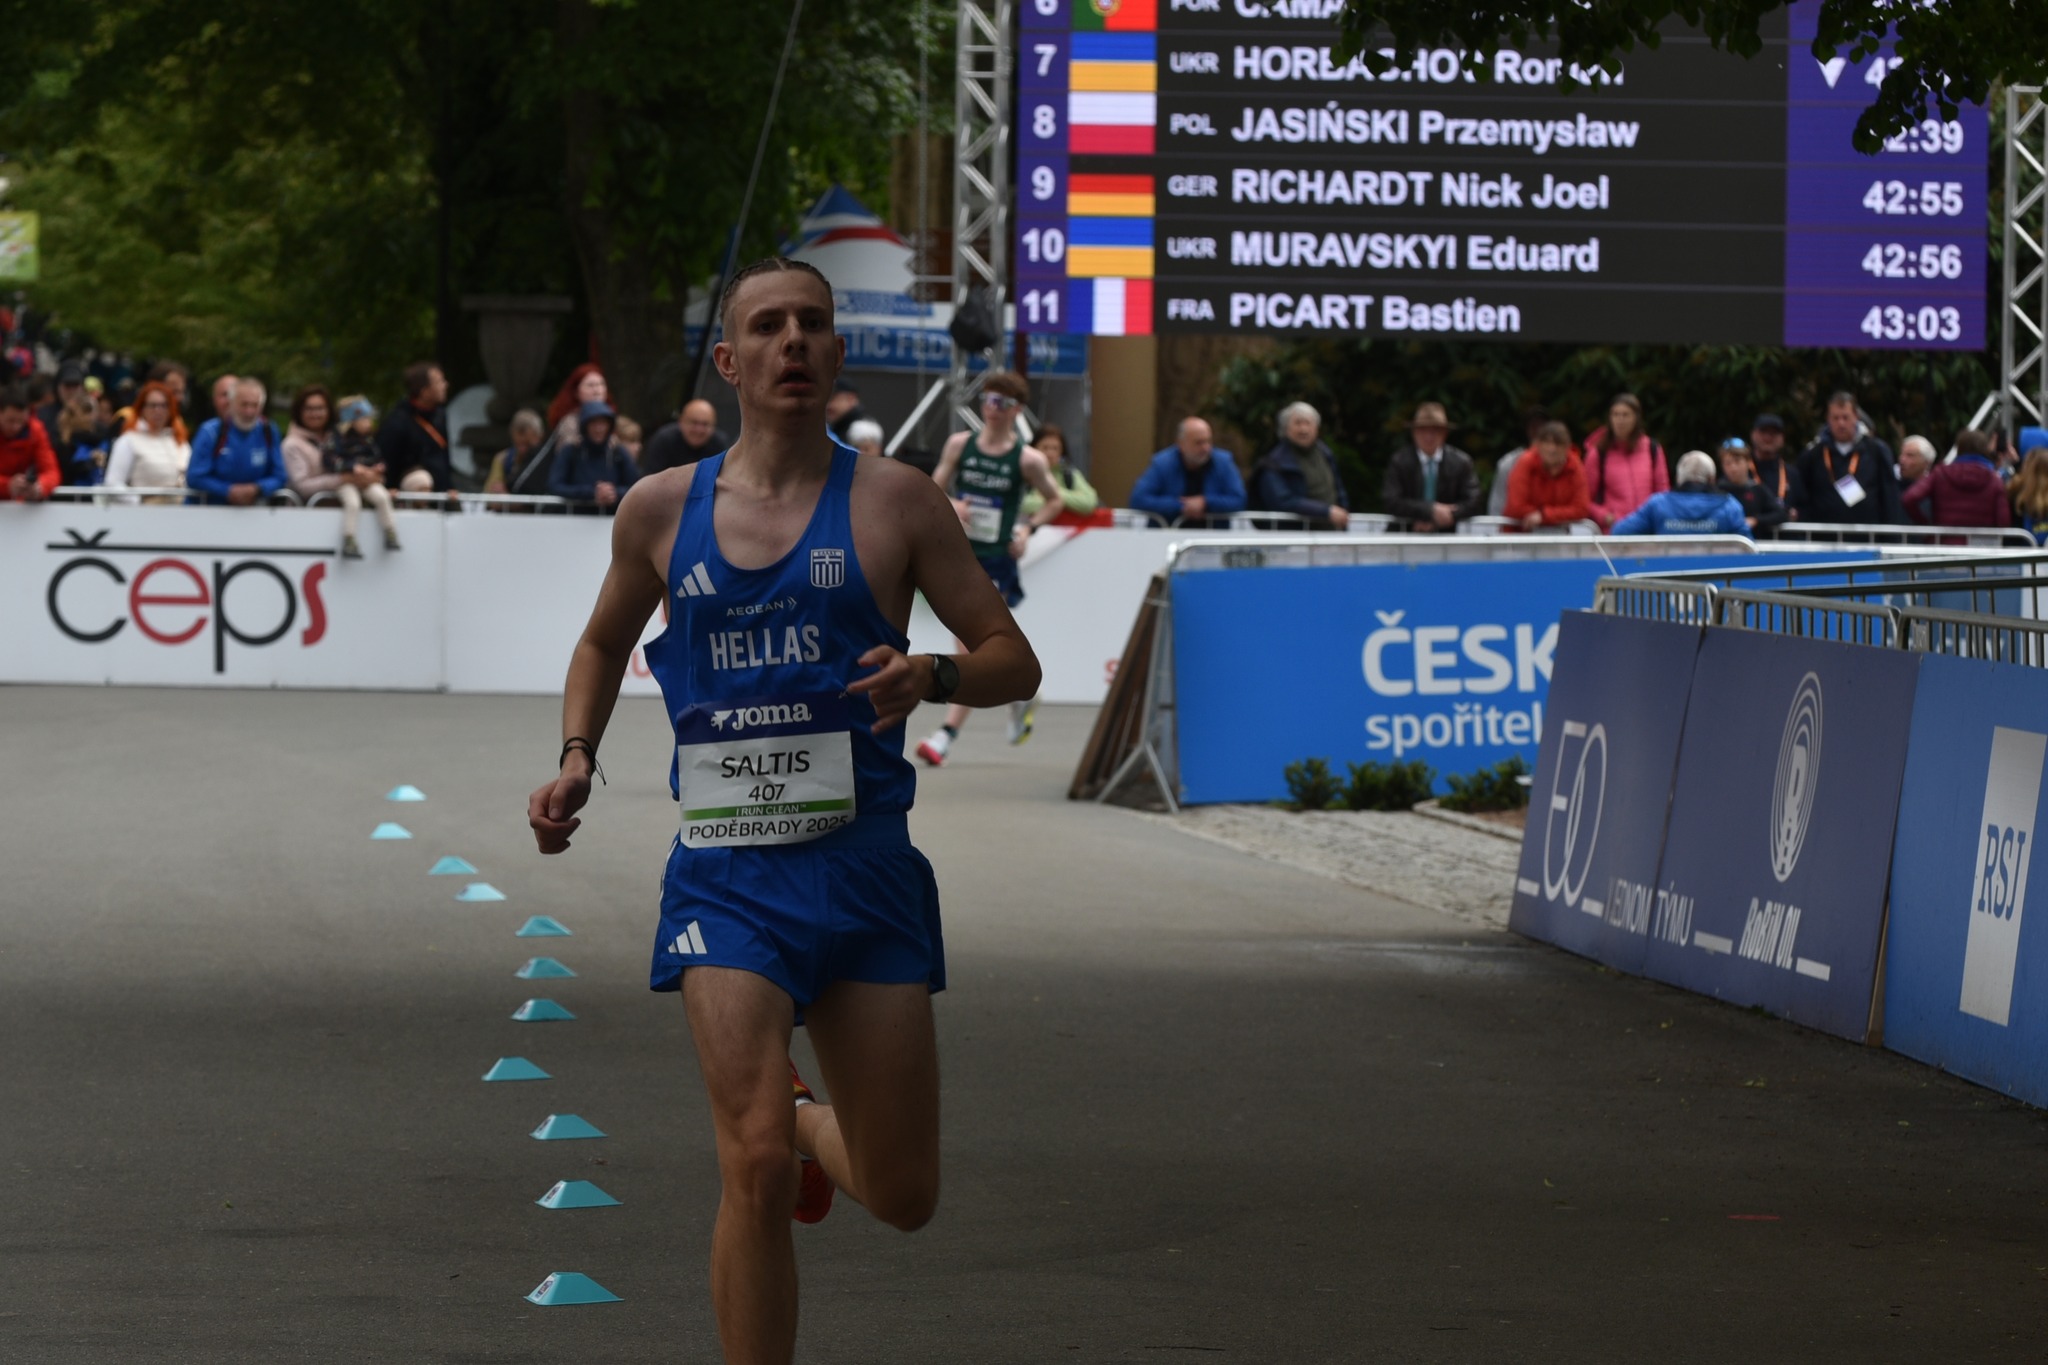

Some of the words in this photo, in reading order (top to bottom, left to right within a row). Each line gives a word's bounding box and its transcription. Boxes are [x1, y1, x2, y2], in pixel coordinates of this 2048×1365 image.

[1033, 43, 1057, 76] 7
[1169, 52, 1219, 73] UKR
[1033, 104, 1056, 139] 8
[1169, 113, 1217, 135] POL
[1231, 100, 1409, 143] JASIŃSKI
[1419, 110, 1640, 154] Przemysław
[1868, 118, 1964, 154] 2:39
[1031, 165, 1055, 200] 9
[1167, 175, 1218, 197] GER
[1232, 168, 1434, 206] RICHARDT
[1441, 172, 1524, 208] Nick
[1531, 174, 1610, 210] Joel
[1862, 180, 1964, 216] 42:55
[1022, 228, 1065, 263] 10
[1167, 237, 1217, 259] UKR
[1231, 231, 1457, 269] MURAVSKYI
[1467, 235, 1600, 272] Eduard
[1861, 243, 1963, 279] 42:56
[1022, 289, 1059, 324] 11
[1167, 298, 1215, 320] FRA
[1230, 292, 1374, 329] PICART
[1382, 296, 1521, 332] Bastien
[1860, 305, 1961, 341] 43:03
[726, 600, 784, 617] AEGEAN
[708, 624, 822, 671] HELLAS
[1361, 609, 1561, 698] ČESK
[1364, 700, 1544, 759] spořitel
[720, 750, 811, 779] SALTIS
[741, 805, 763, 816] RUN
[748, 783, 786, 802] 407
[688, 818, 803, 840] PODĚBRADY
[806, 814, 849, 833] 2025
[1976, 823, 2027, 922] RSJ
